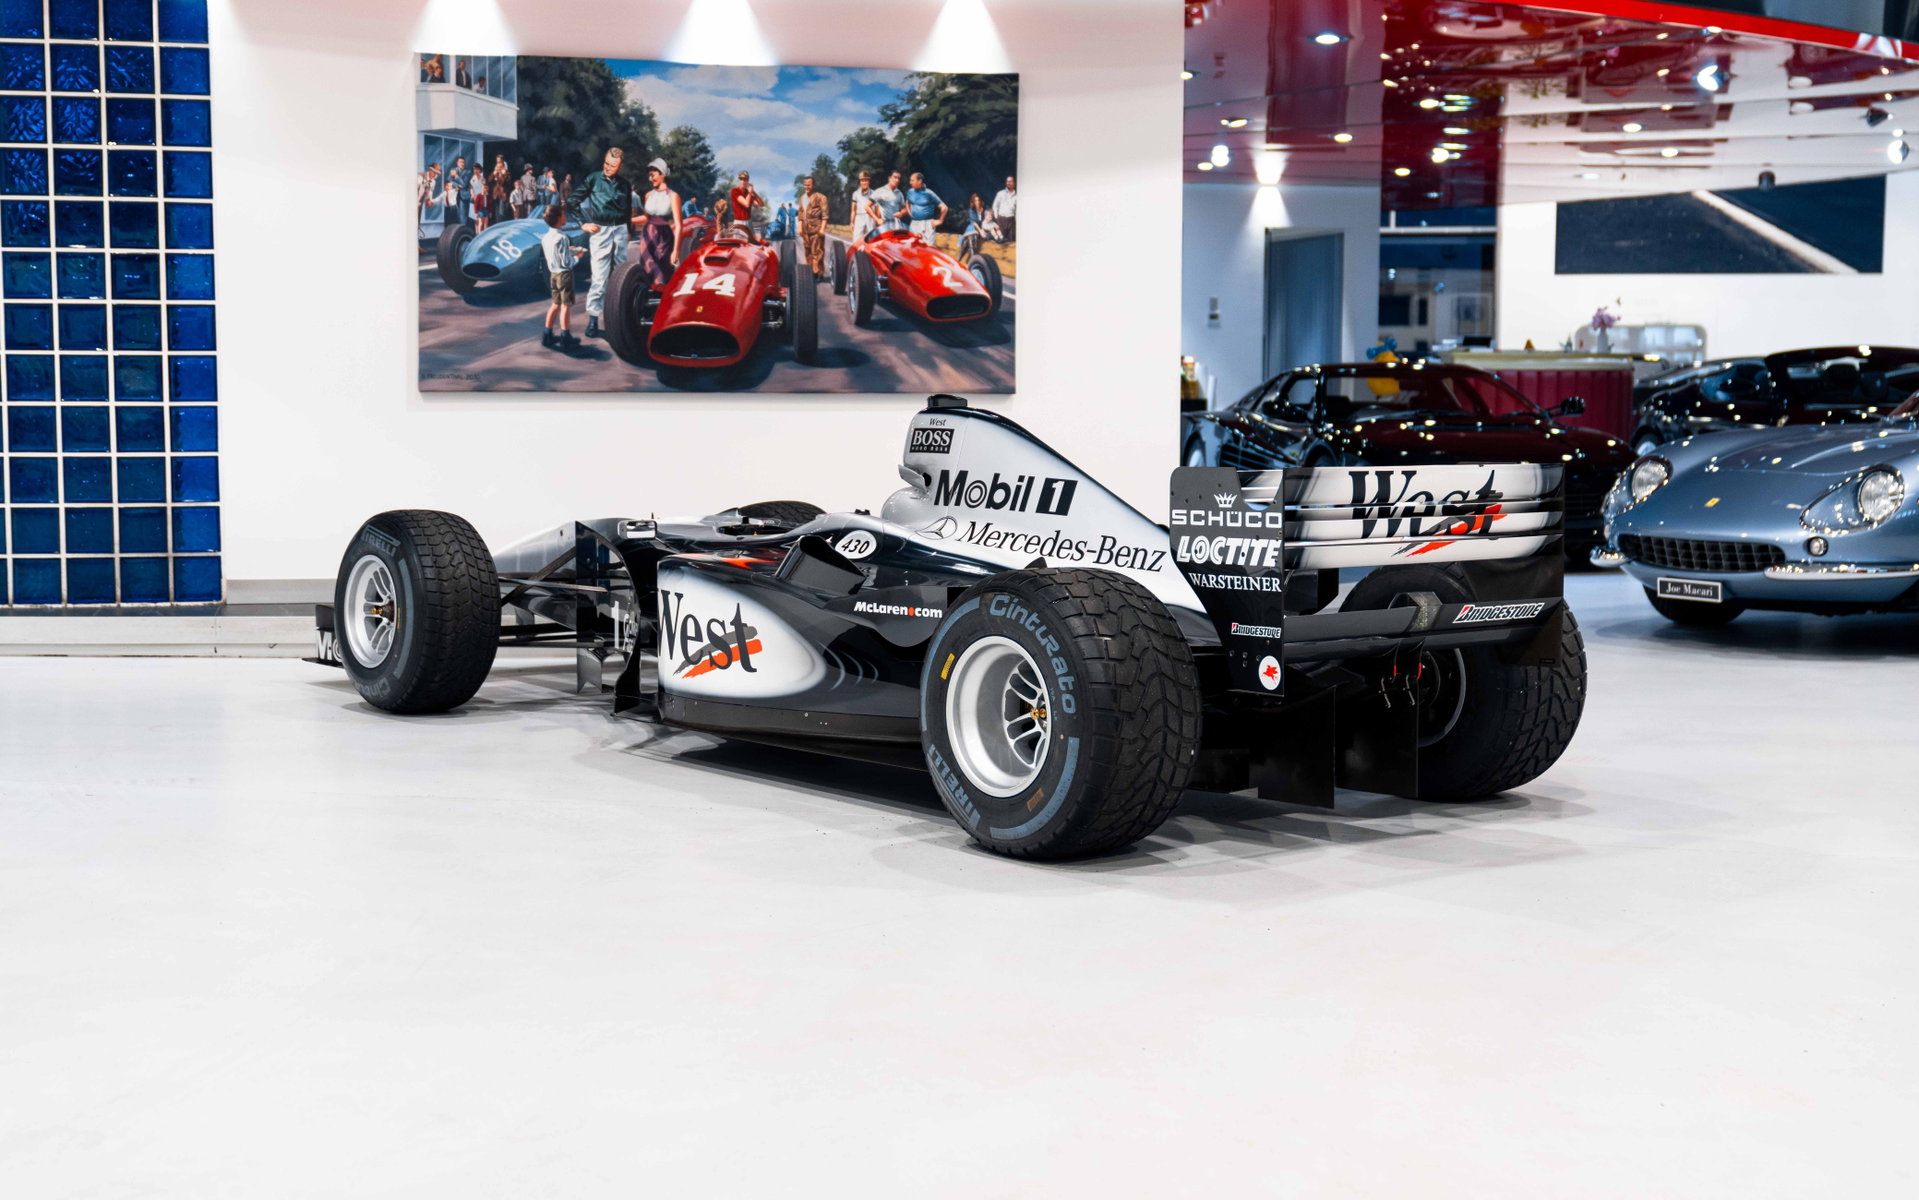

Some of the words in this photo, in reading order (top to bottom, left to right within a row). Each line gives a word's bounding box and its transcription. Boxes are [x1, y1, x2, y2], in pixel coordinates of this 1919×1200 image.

[491, 239, 522, 261] 18
[672, 272, 736, 297] 14
[932, 266, 962, 288] 2
[929, 417, 947, 426] West
[912, 430, 951, 446] BOSS
[935, 470, 1035, 512] Mobil
[1348, 469, 1504, 539] West
[1171, 509, 1283, 529] SCHÜCO
[361, 524, 401, 557] PIRELLI
[841, 538, 871, 554] 430
[957, 521, 1167, 572] Mercedes-Benz
[1176, 535, 1282, 568] LOCTITE
[1188, 572, 1282, 593] WARSTEINER
[1665, 582, 1681, 594] Joe
[1683, 584, 1713, 597] Macari
[658, 588, 757, 672] West
[989, 594, 1078, 714] Cinturato
[927, 743, 981, 831] PIRELLI
